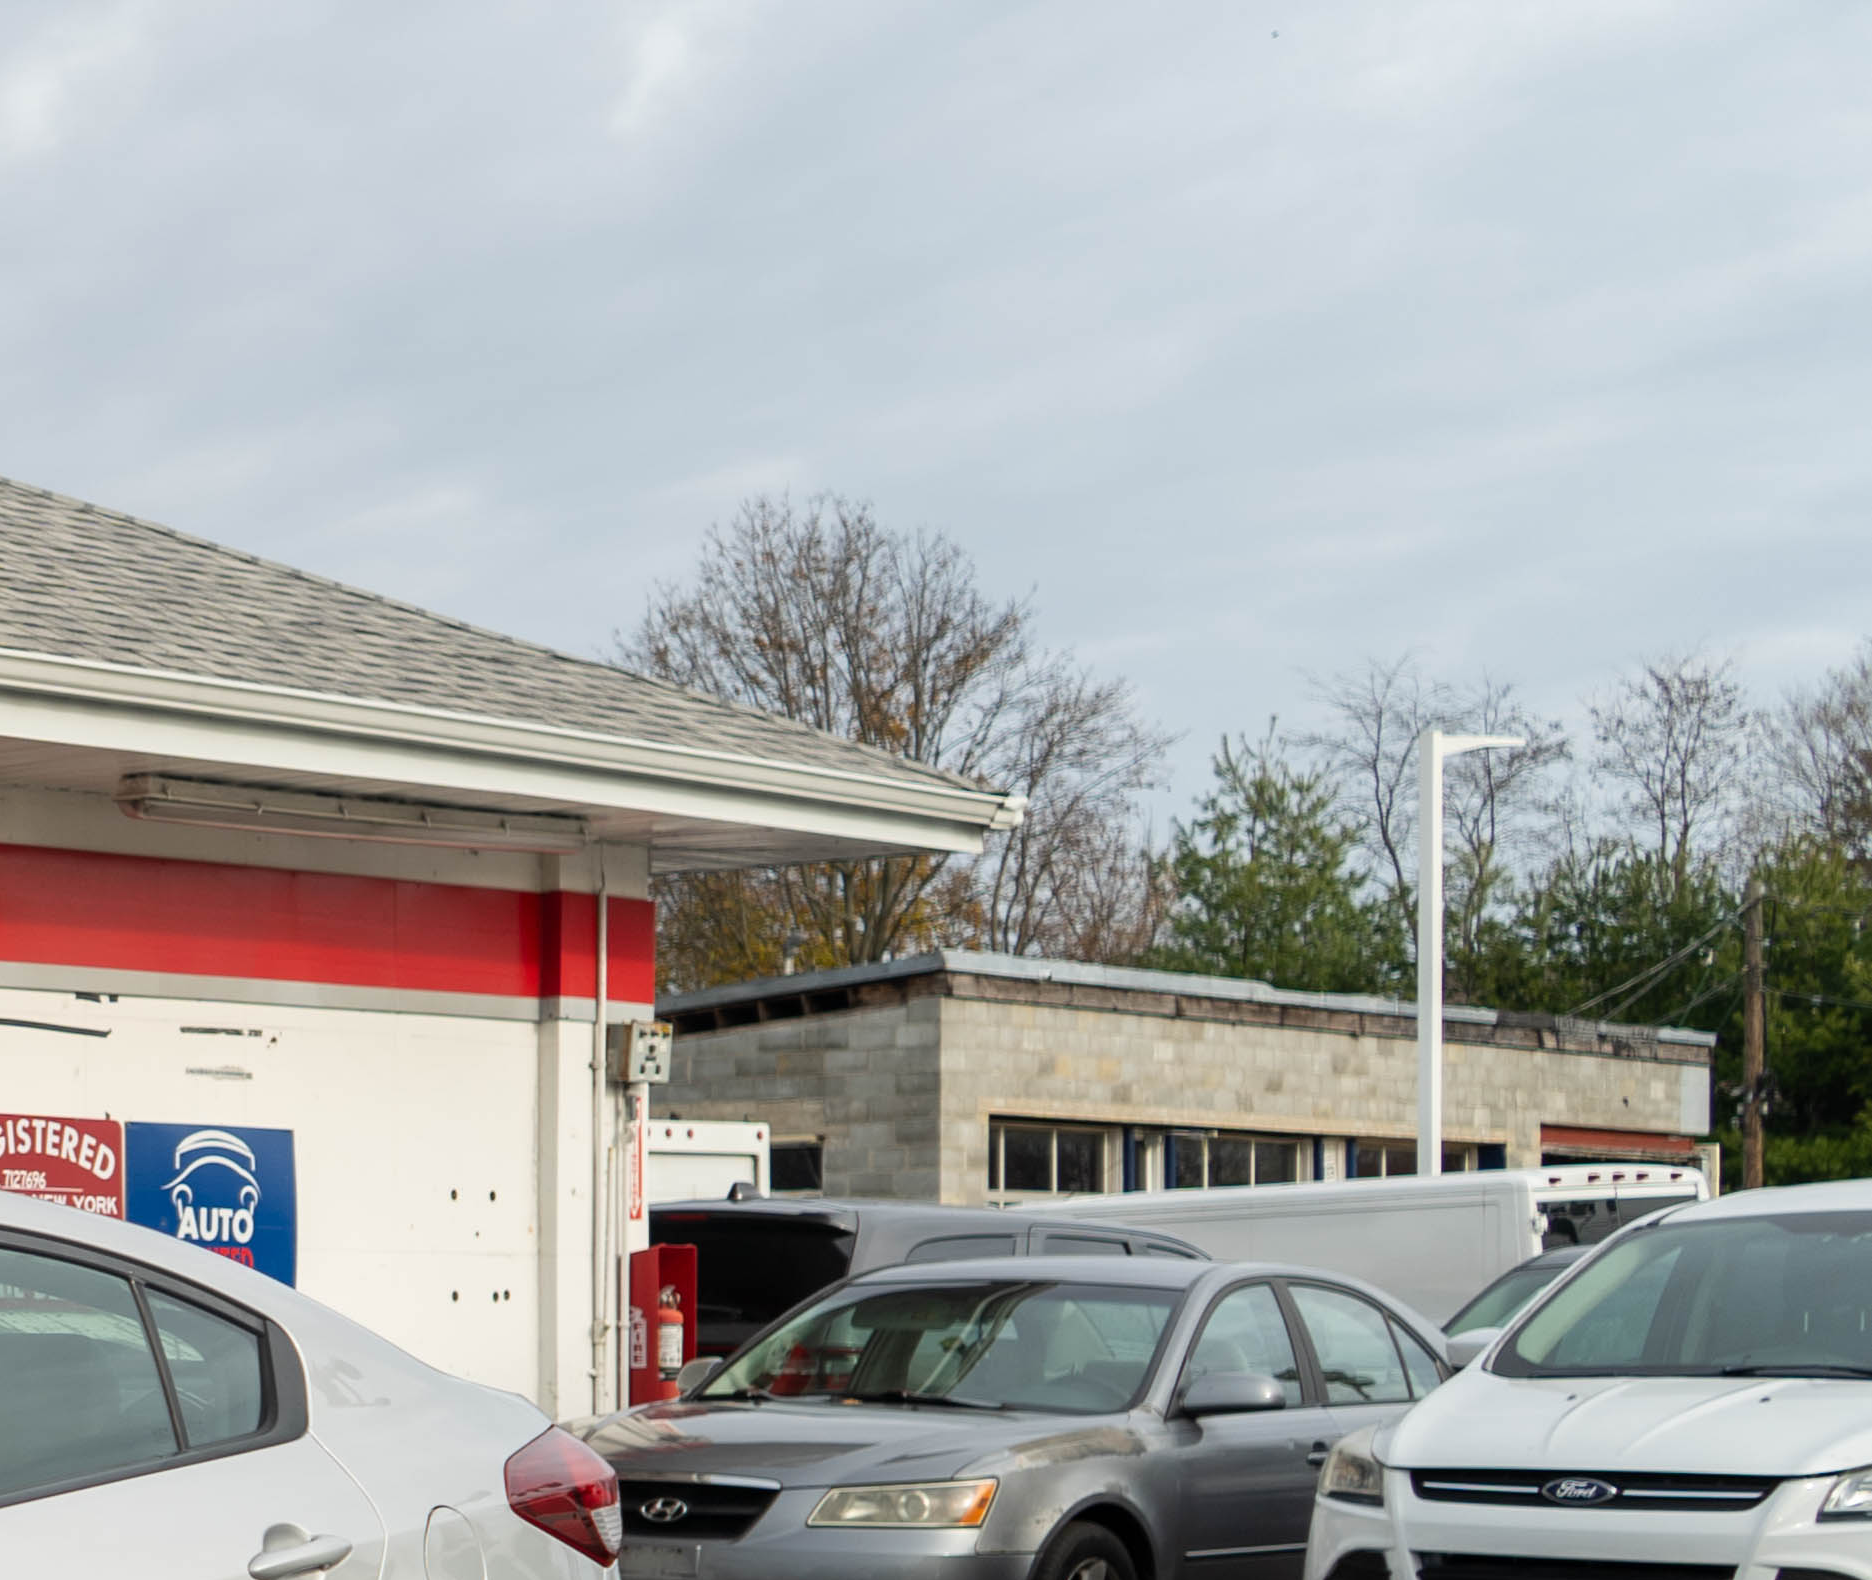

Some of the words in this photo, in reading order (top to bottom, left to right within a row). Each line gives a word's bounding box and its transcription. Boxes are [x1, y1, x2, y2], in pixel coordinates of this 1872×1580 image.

[3, 1169, 47, 1190] 7127696
[72, 1194, 118, 1216] YORK
[177, 1206, 254, 1244] AUTO
[1556, 1480, 1597, 1499] Ford
